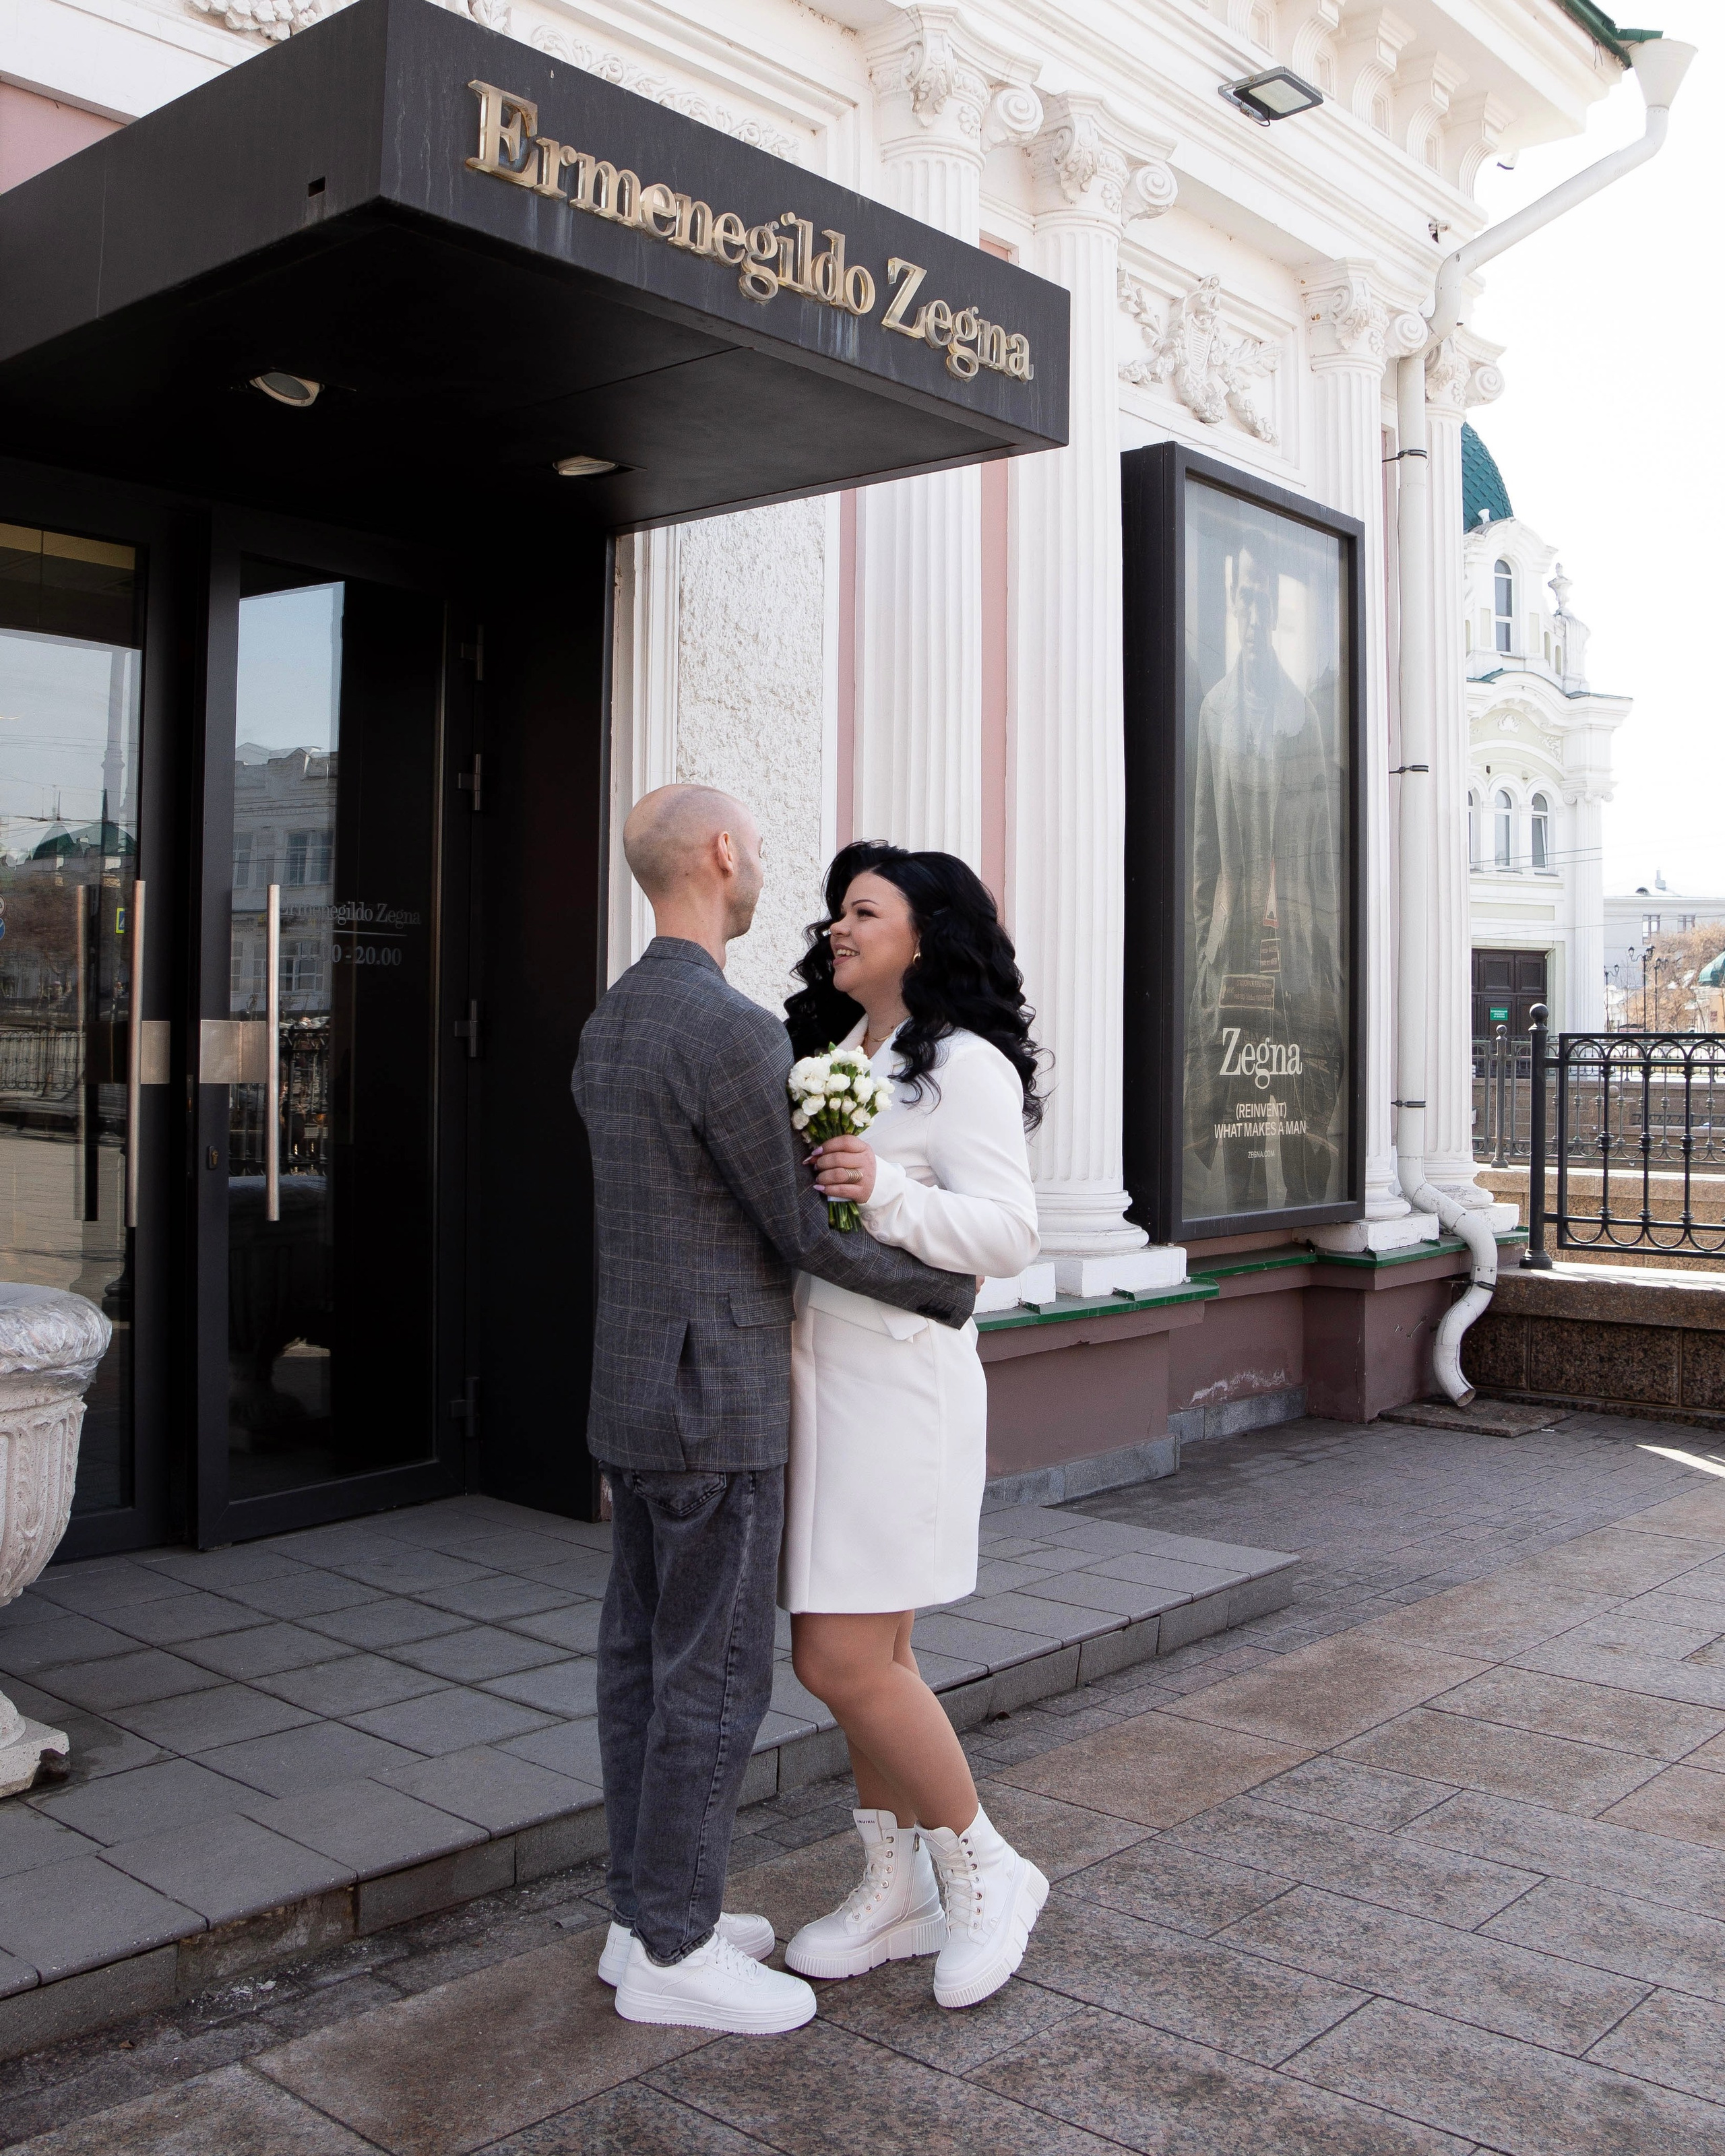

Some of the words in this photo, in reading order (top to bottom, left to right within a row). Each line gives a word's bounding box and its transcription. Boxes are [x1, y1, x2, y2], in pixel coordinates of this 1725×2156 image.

[466, 80, 876, 316] Ermenegildo
[881, 257, 1034, 382] Zegna
[376, 903, 421, 929] Zegna
[354, 946, 402, 966] 20.00
[1220, 1027, 1303, 1089] Zegna
[1236, 1102, 1287, 1120] (REINVENT)
[1214, 1122, 1243, 1139] WHAT
[1244, 1121, 1276, 1137] MAKES
[1278, 1121, 1284, 1135] A
[1286, 1120, 1307, 1135] MAN
[1247, 1149, 1276, 1159] ZEGNA.COM
